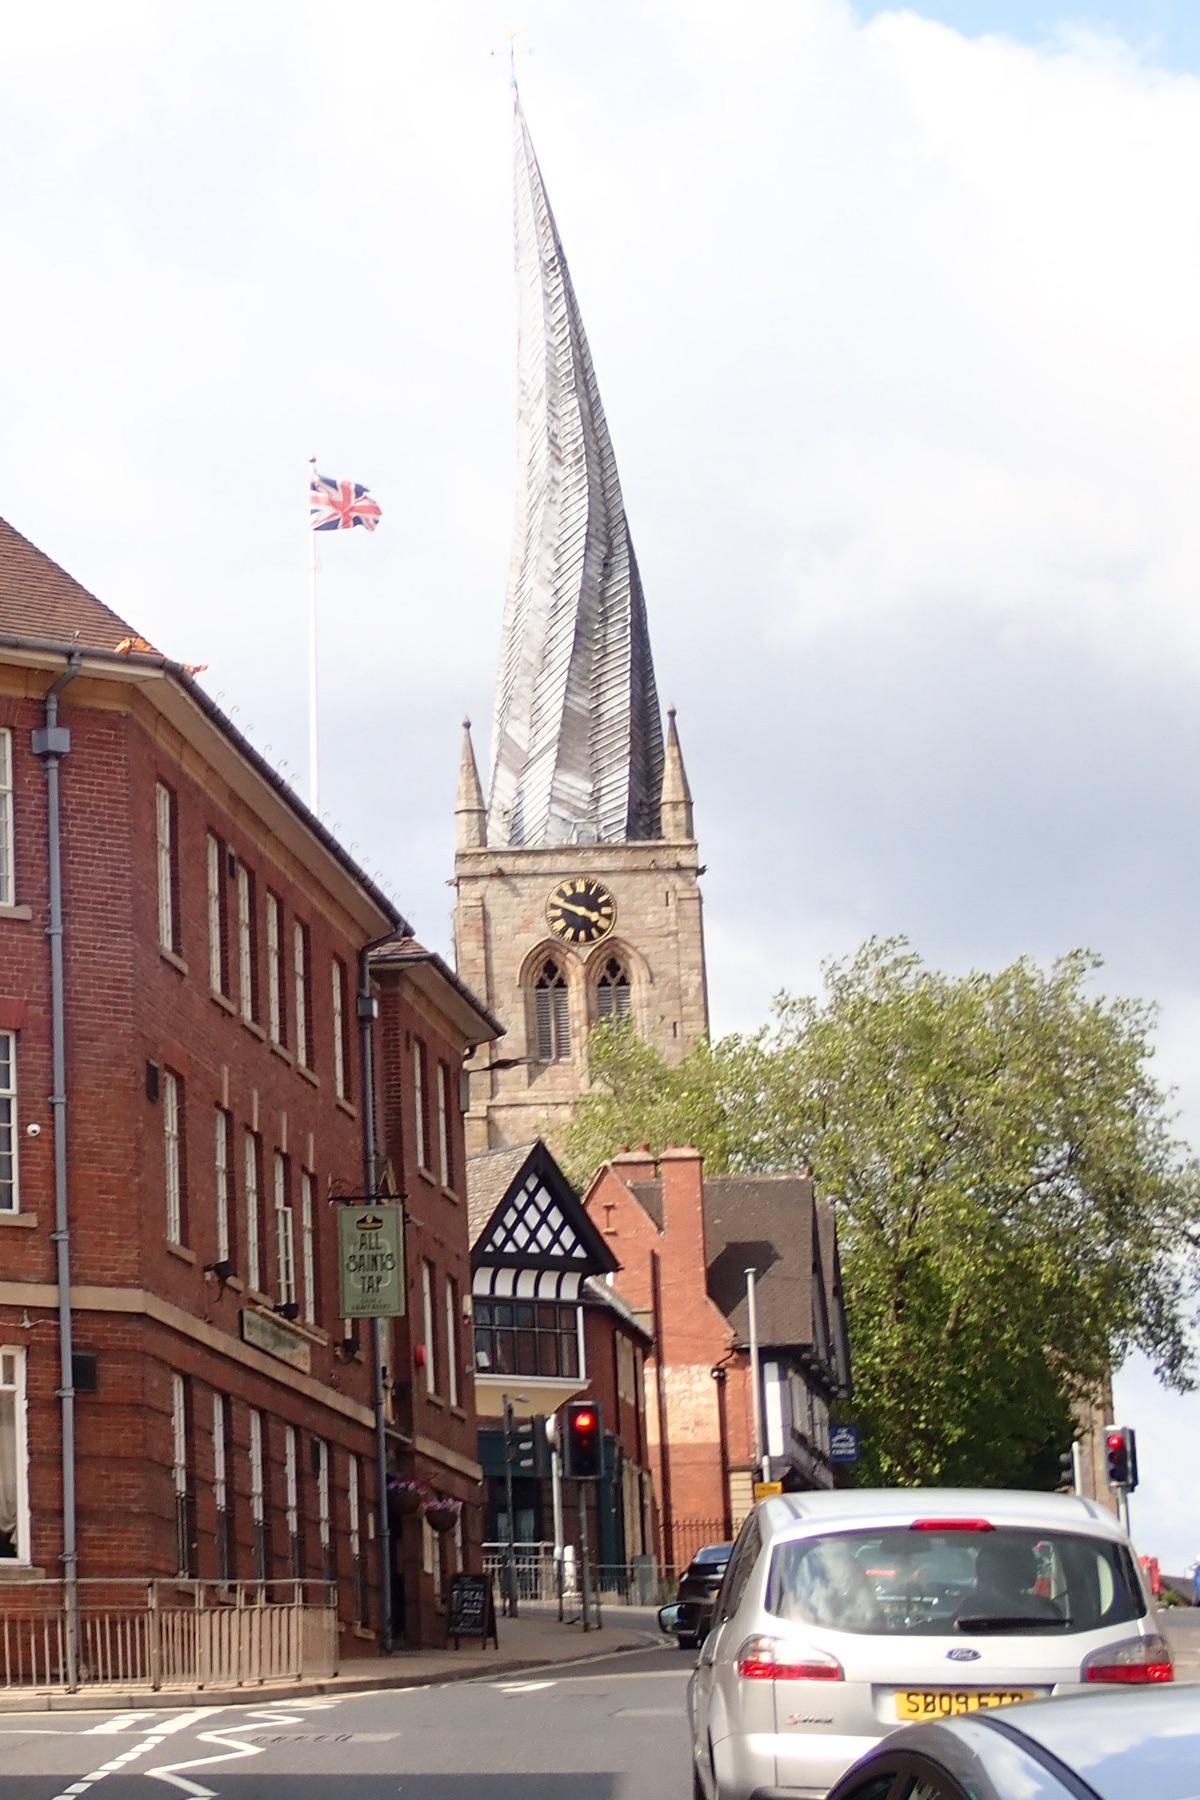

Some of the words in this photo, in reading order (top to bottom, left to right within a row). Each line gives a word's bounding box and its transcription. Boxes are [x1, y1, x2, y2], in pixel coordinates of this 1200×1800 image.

[359, 1231, 382, 1251] ALL
[346, 1252, 396, 1273] SAINTS
[361, 1275, 382, 1294] TAP
[906, 1692, 969, 1715] SB09
